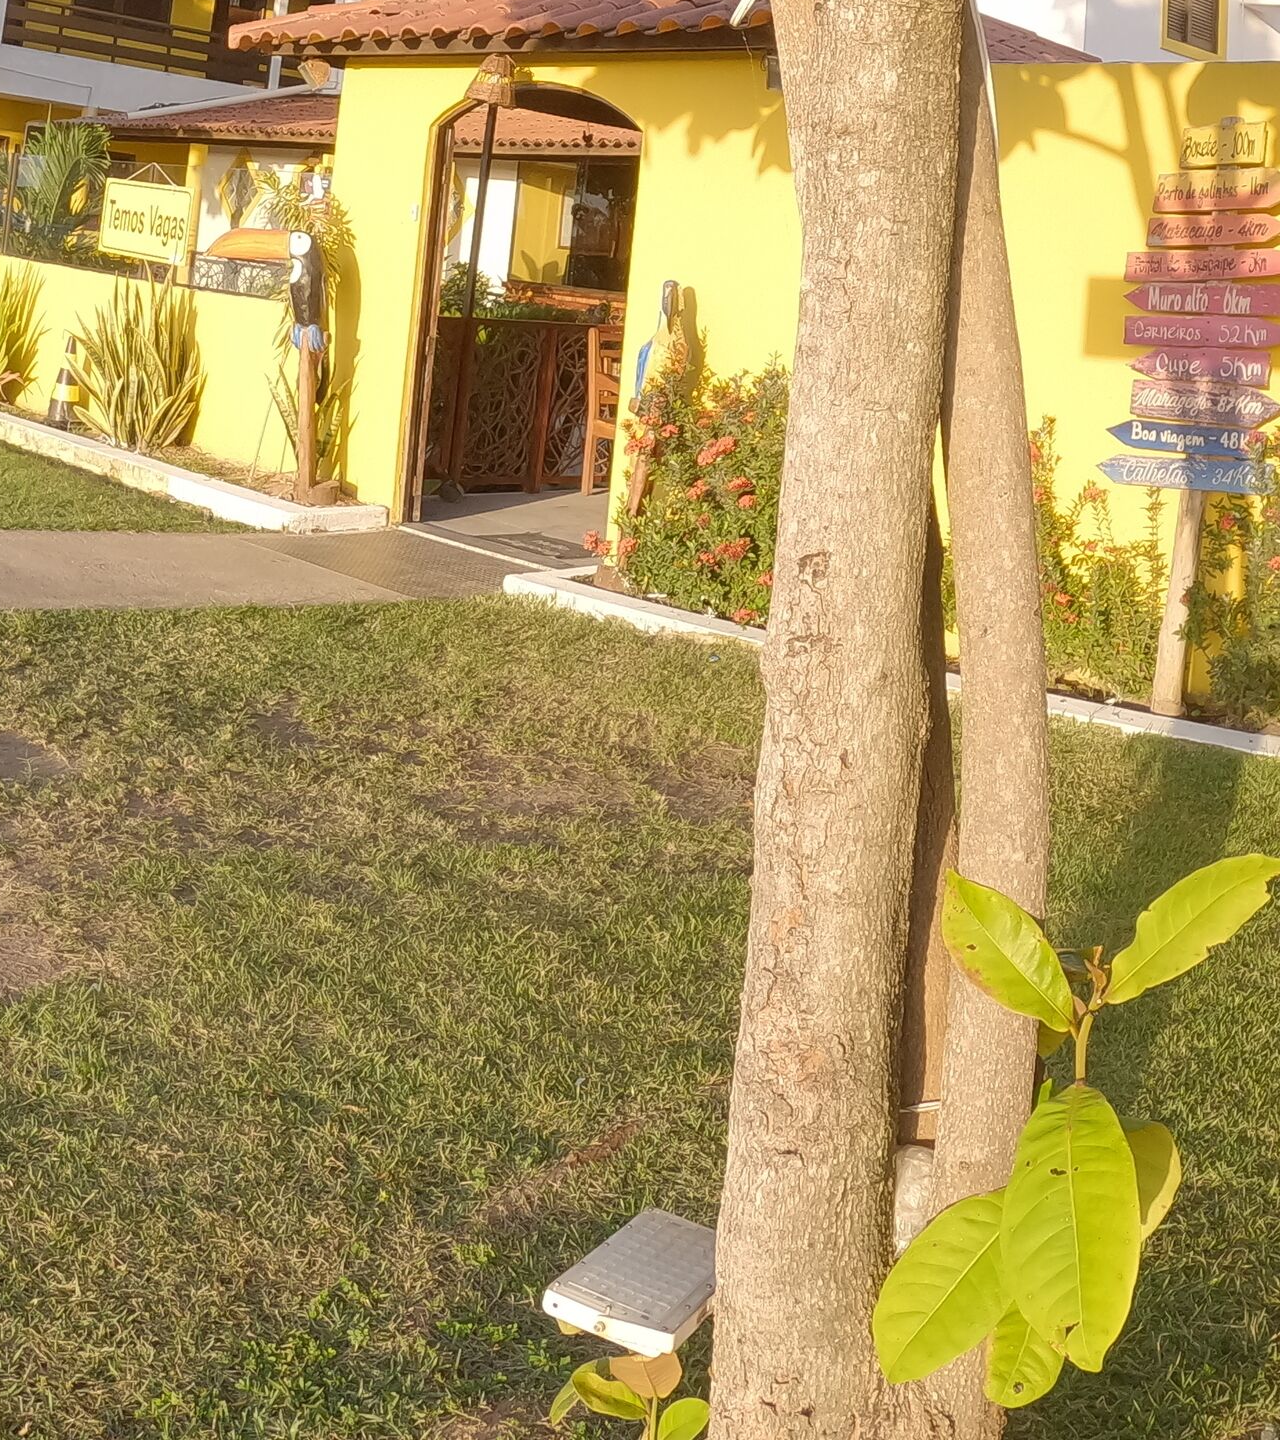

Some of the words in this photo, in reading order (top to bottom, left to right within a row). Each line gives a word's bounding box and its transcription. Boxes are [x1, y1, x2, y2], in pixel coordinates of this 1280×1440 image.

[1186, 180, 1196, 200] de
[108, 198, 146, 235] Temos
[150, 204, 185, 247] Vagas
[1148, 286, 1182, 311] Muro
[1184, 285, 1209, 312] alto
[1223, 285, 1252, 314] 6km
[1155, 352, 1202, 377] Cupe
[1220, 356, 1262, 381] 5Km
[1131, 421, 1157, 442] Boa
[1160, 429, 1205, 451] viagem
[1123, 460, 1188, 483] Calhetas
